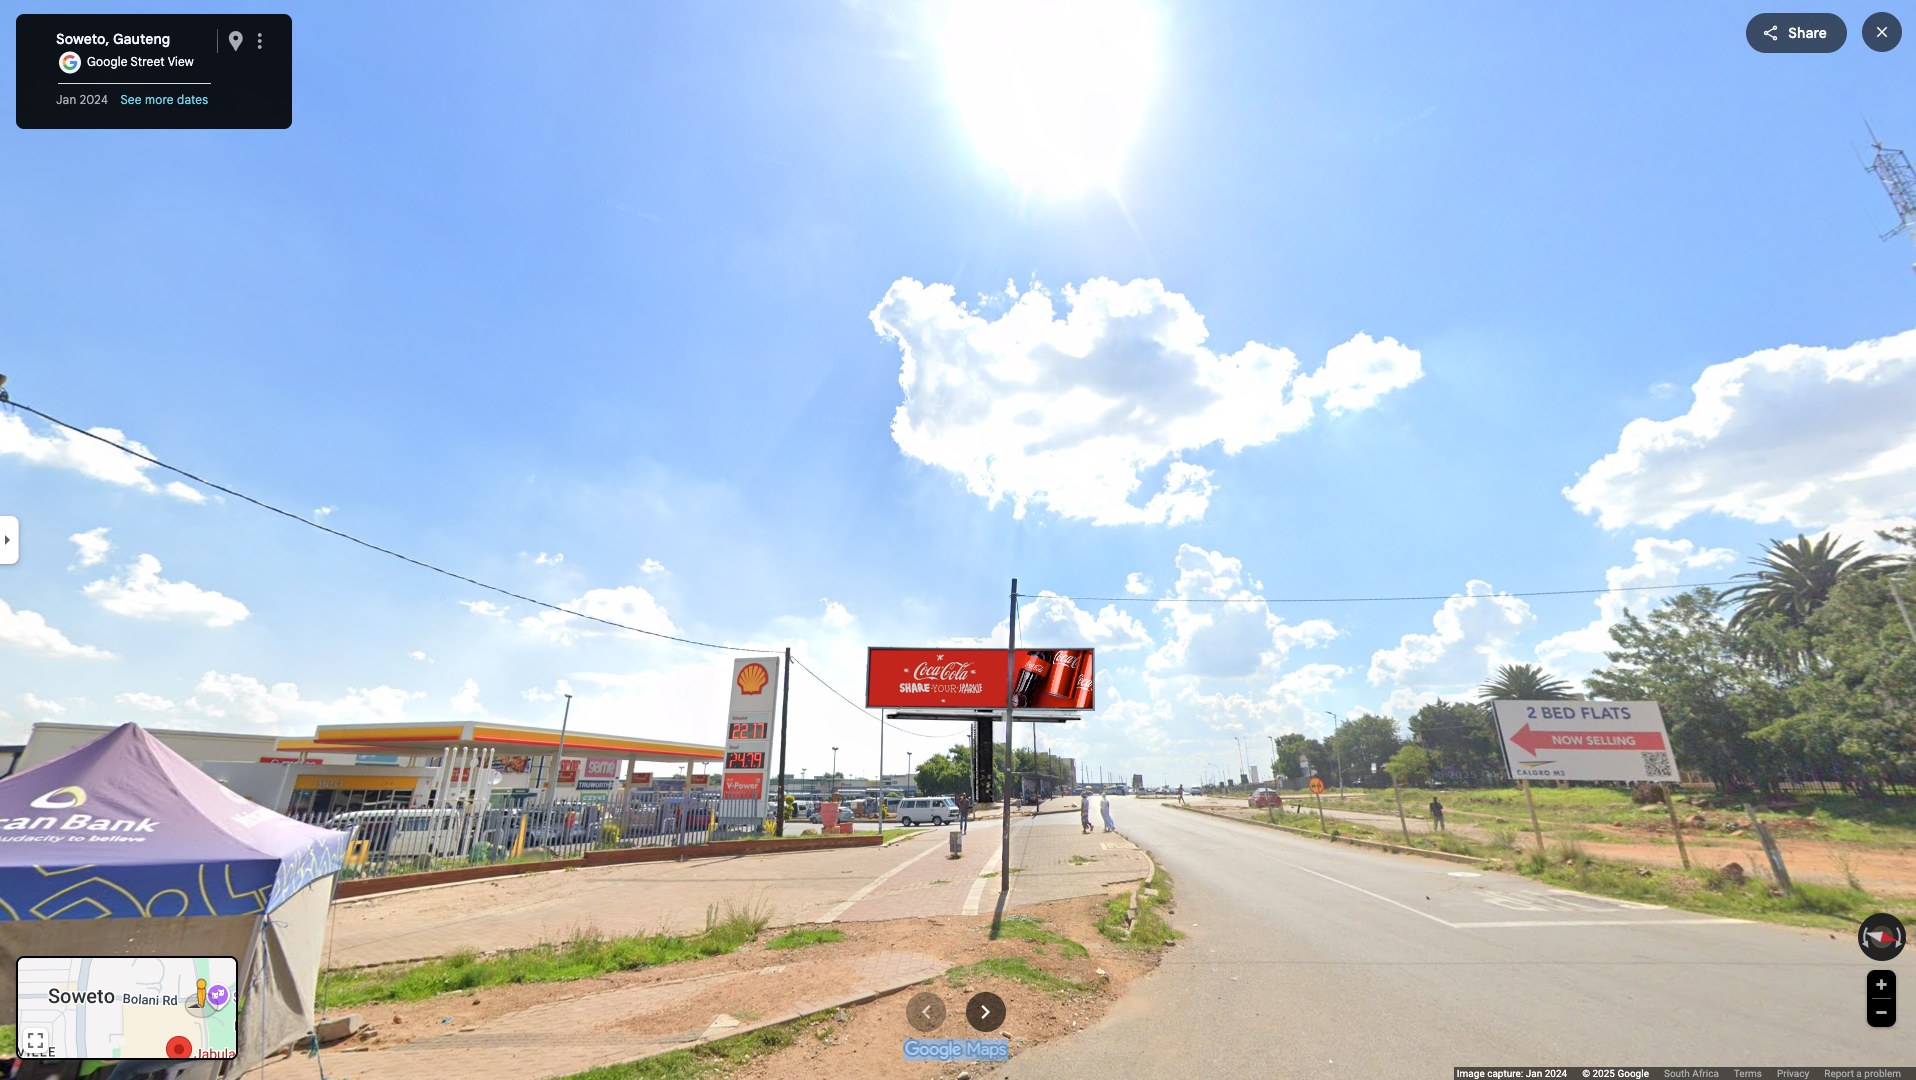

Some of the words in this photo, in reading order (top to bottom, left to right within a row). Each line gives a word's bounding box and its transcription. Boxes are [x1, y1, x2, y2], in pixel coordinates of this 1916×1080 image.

[913, 661, 972, 681] Coca-Cola
[899, 682, 931, 694] SHARE
[1526, 706, 1537, 719] 2
[1541, 707, 1576, 719] BED
[1581, 707, 1632, 720] FLATS
[1552, 735, 1584, 745] NOW
[1587, 736, 1636, 746] SELLING
[726, 781, 759, 790] V-Power
[59, 814, 160, 833] Bank
[0, 835, 65, 844] udacity
[88, 835, 146, 843] believe
